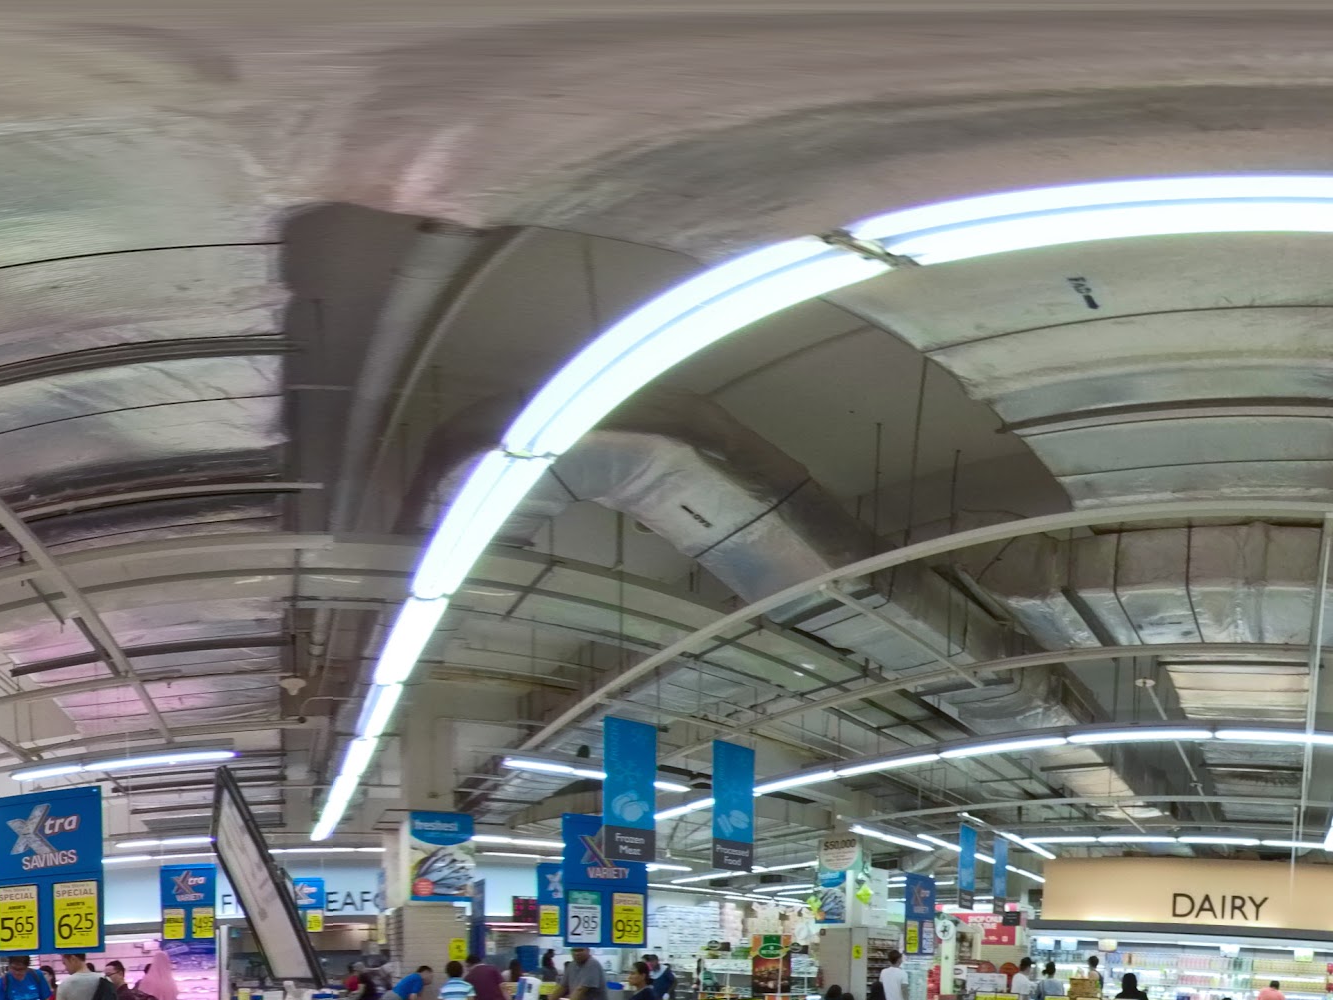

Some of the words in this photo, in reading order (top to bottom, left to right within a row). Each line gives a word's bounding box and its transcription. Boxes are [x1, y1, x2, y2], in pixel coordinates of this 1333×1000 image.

[6, 803, 81, 855] Xtra
[615, 833, 645, 844] Frozen
[21, 849, 78, 871] SAVINGS
[724, 855, 742, 866] Food
[587, 867, 630, 879] VARIETY
[55, 888, 95, 898] SPECIAL
[1171, 892, 1269, 921] DAIRY
[0, 915, 35, 942] 5.65
[57, 912, 95, 940] 6.25
